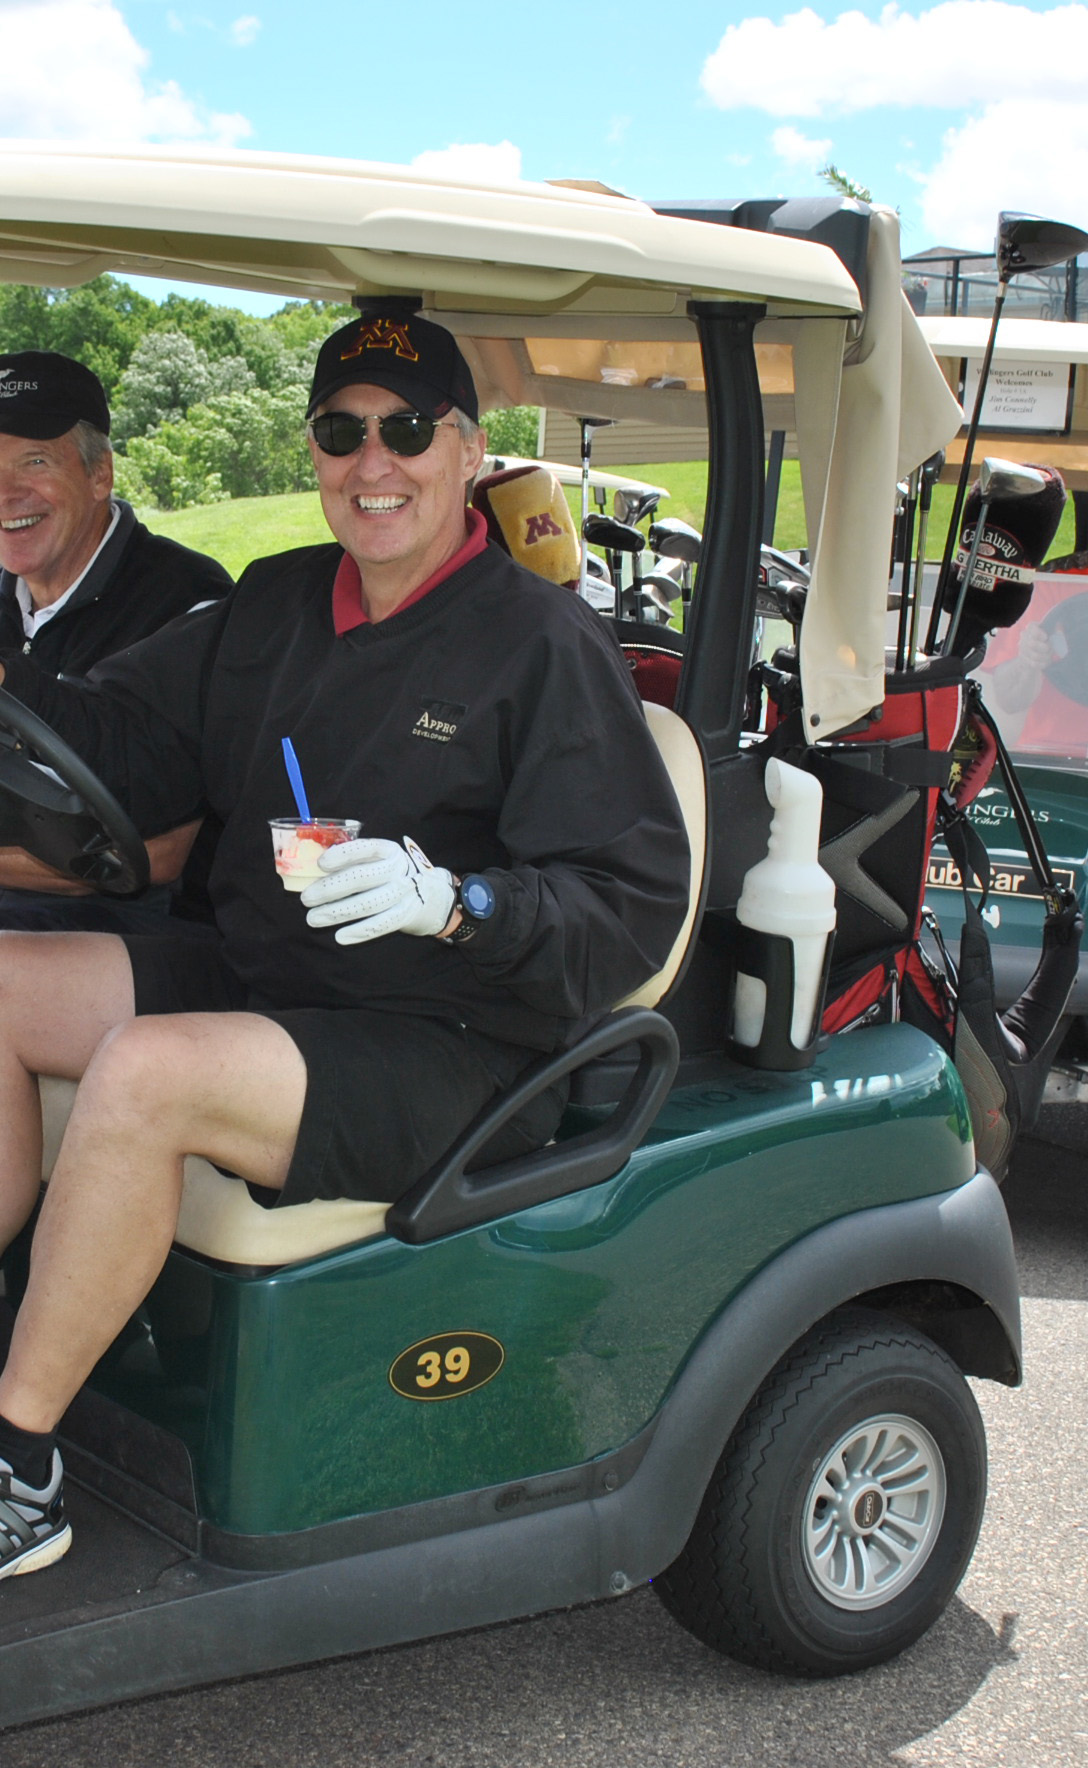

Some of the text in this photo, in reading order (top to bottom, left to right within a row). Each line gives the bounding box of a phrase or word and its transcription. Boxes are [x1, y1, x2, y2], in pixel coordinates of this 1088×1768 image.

[995, 378, 1033, 386] Welcomes
[1016, 369, 1033, 377] Golf
[1035, 369, 1054, 377] Club
[962, 527, 1018, 558] Calaway
[974, 558, 1020, 580] ERTHA
[415, 1346, 471, 1389] 39
